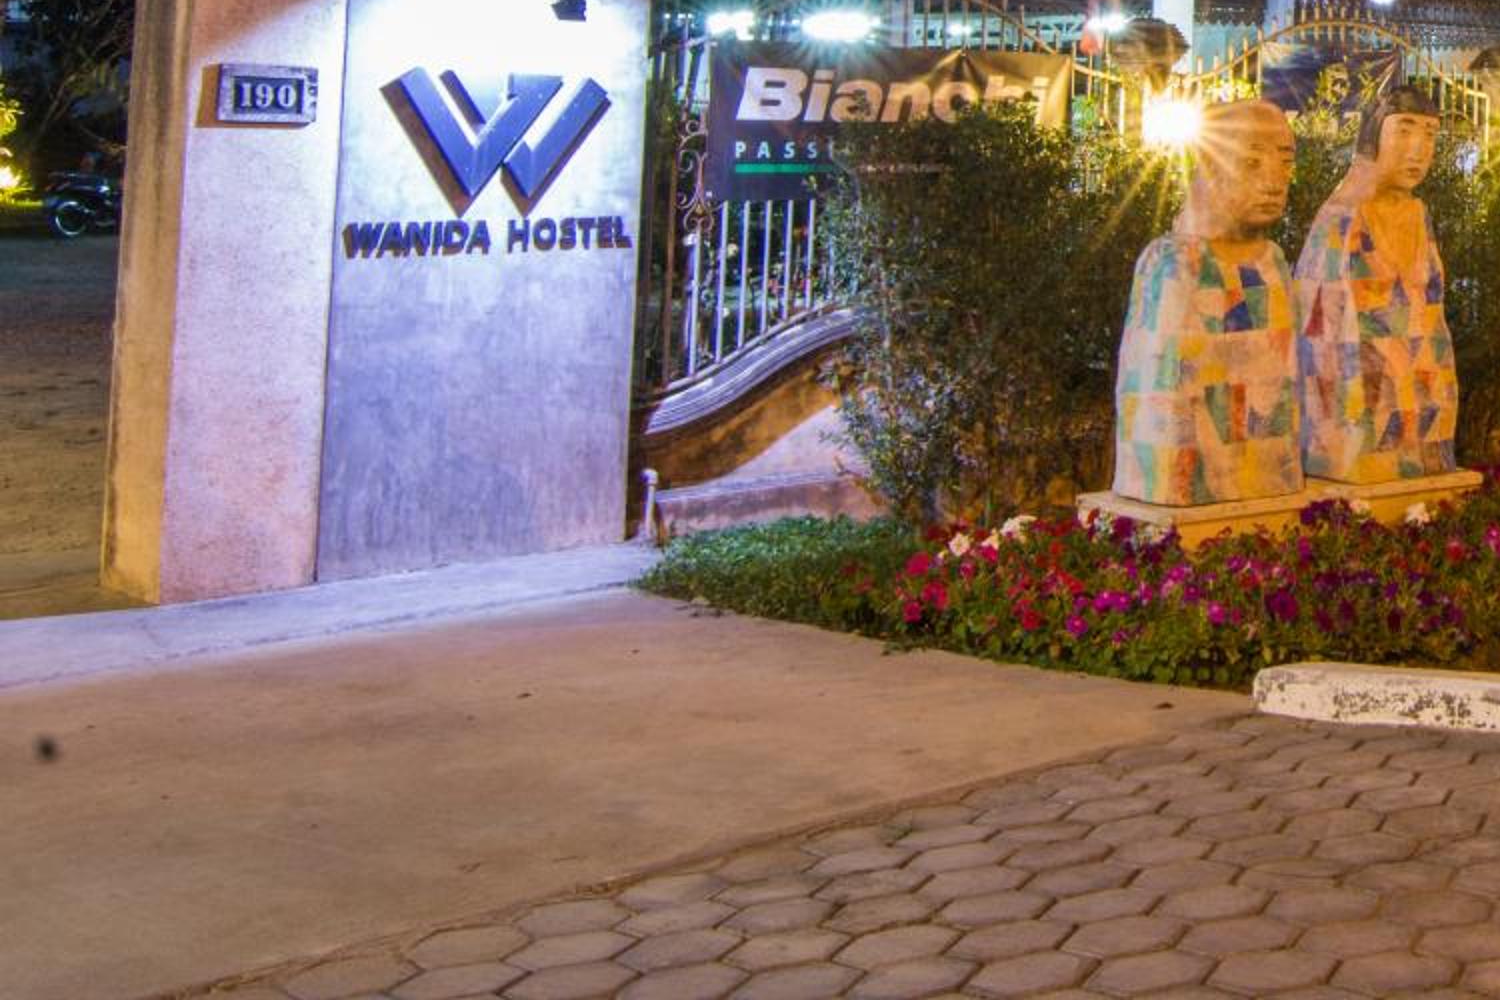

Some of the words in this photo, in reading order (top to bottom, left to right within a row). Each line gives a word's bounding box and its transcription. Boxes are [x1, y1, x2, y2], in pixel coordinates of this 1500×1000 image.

[240, 82, 298, 109] 190
[342, 219, 491, 259] WANIDA
[506, 215, 633, 253] HOSTEL
